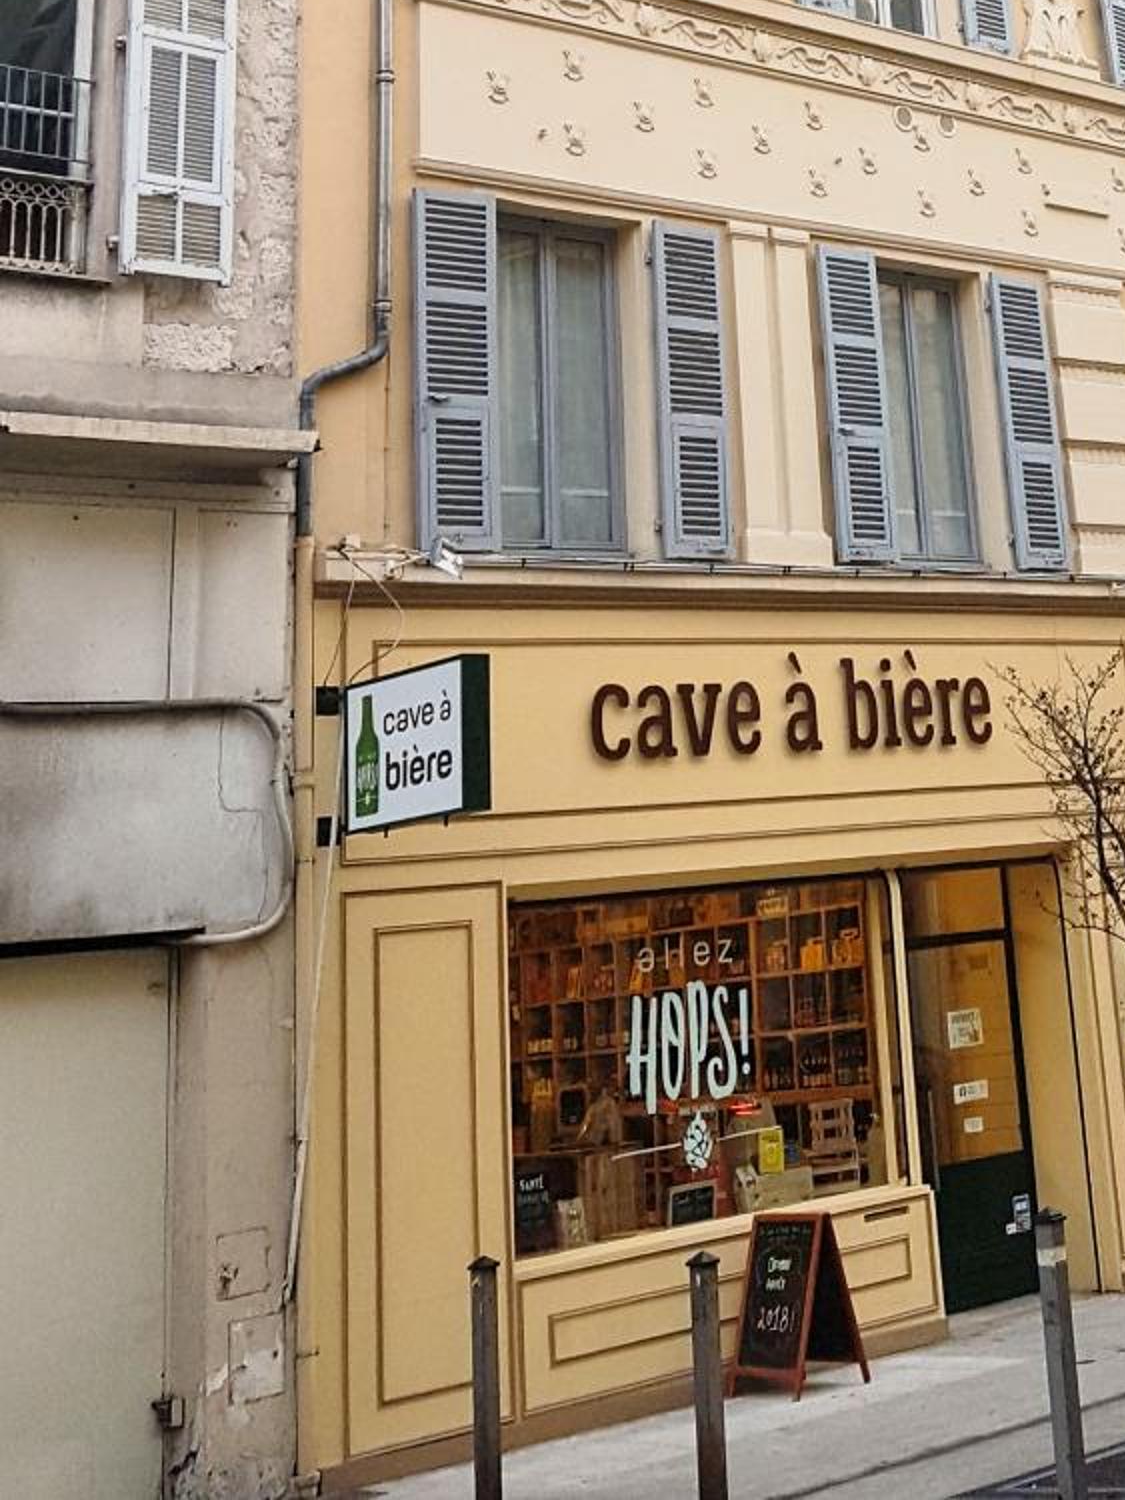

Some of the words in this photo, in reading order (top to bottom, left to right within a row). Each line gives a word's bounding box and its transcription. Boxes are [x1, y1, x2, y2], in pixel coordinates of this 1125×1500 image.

[383, 701, 434, 736] cave
[440, 689, 452, 722] à
[592, 681, 762, 761] cave
[785, 651, 823, 752] à
[840, 649, 993, 750] bière
[385, 744, 453, 791] bière
[625, 979, 751, 1116] HOPS!
